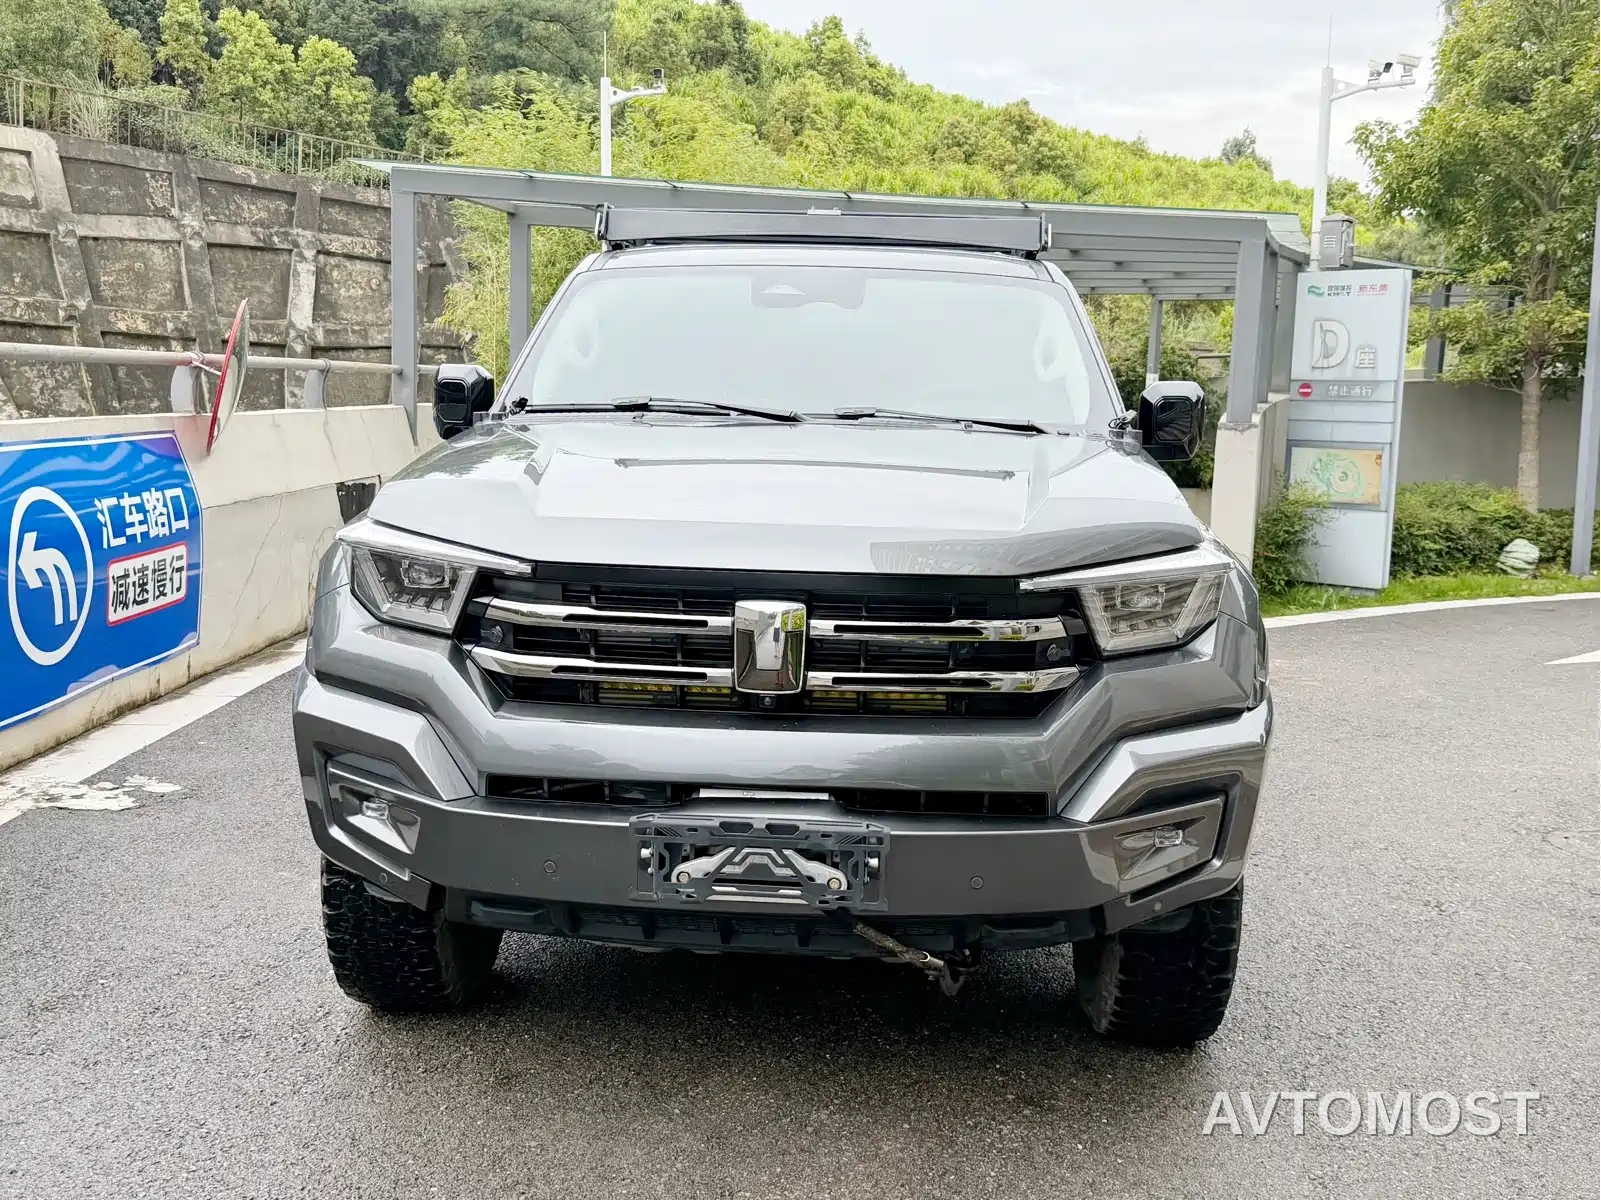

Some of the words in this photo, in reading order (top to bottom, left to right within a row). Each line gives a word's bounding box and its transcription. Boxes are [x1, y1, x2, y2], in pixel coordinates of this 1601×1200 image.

[1327, 385, 1373, 397] 禁止通行
[94, 487, 190, 549] 汇车路口
[111, 554, 185, 614] 减速慢行
